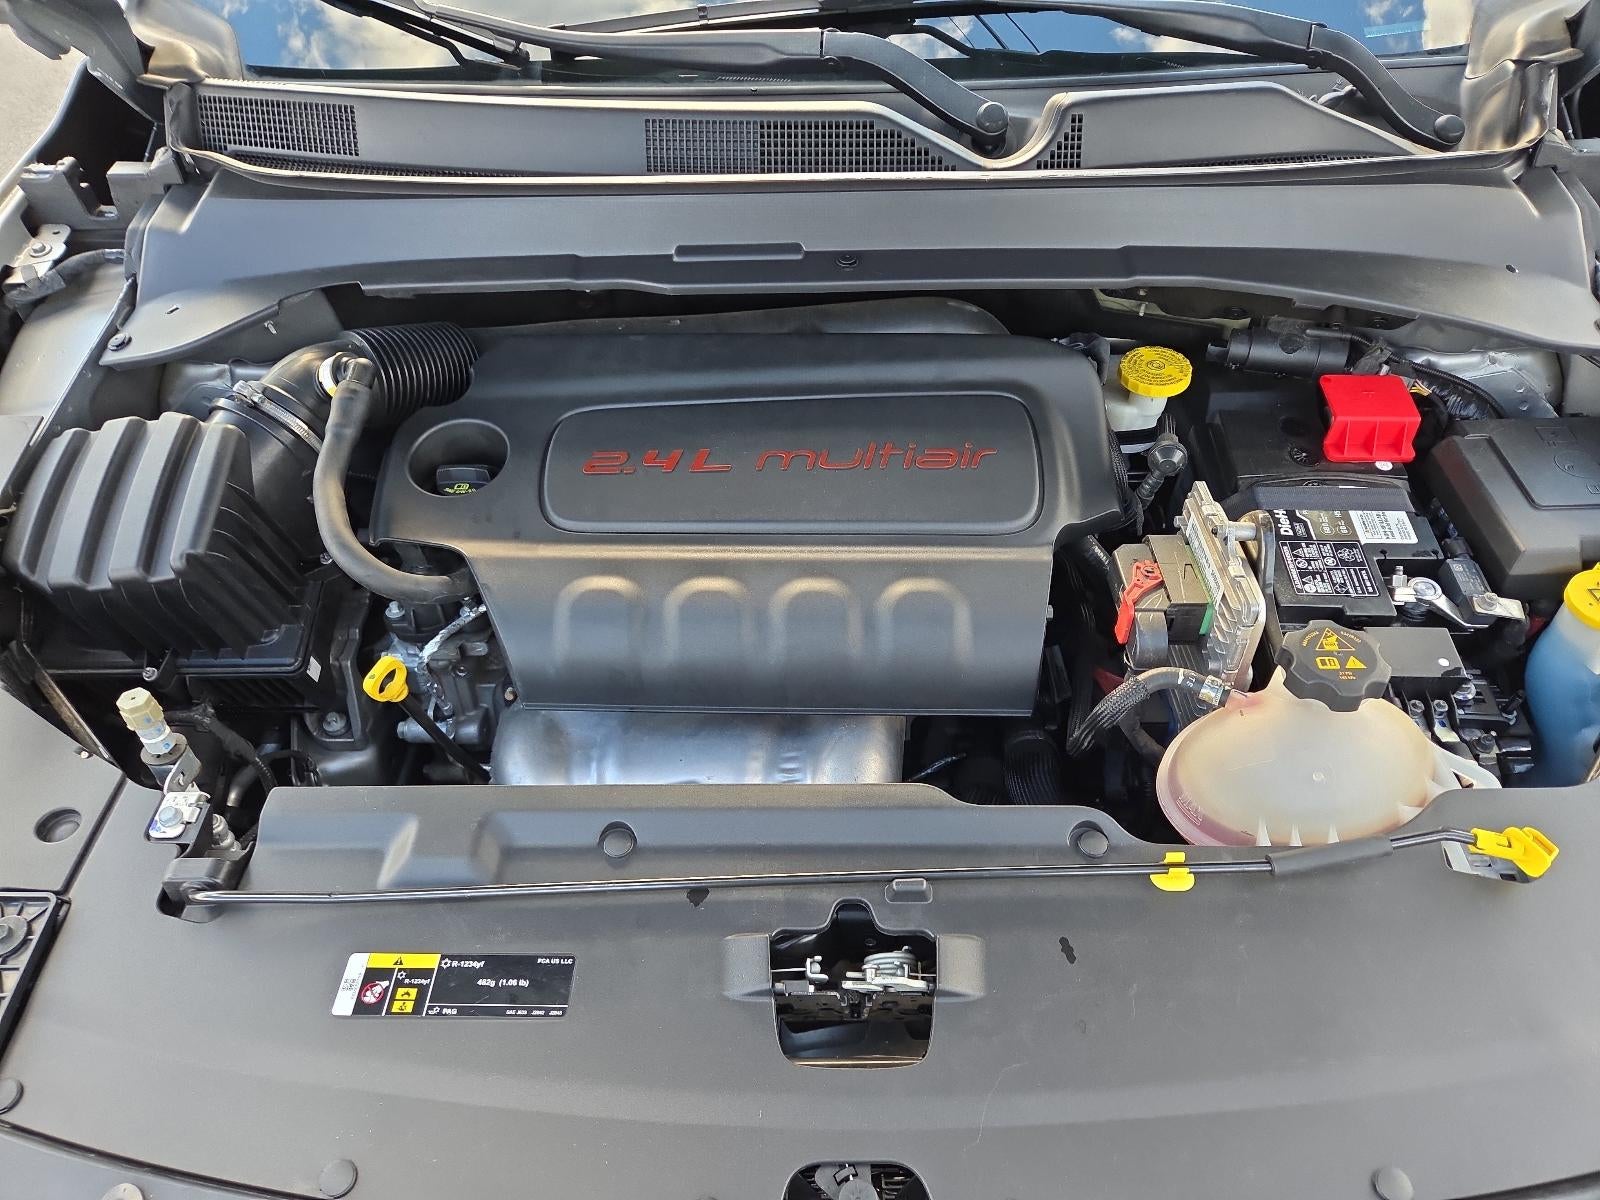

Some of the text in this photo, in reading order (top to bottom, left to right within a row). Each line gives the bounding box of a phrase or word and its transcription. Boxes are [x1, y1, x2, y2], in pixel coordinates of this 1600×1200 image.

[582, 441, 998, 475] 2.4L multiair
[1273, 509, 1294, 536] DieH
[451, 960, 485, 968] R-1234yf
[519, 979, 530, 987] lb)
